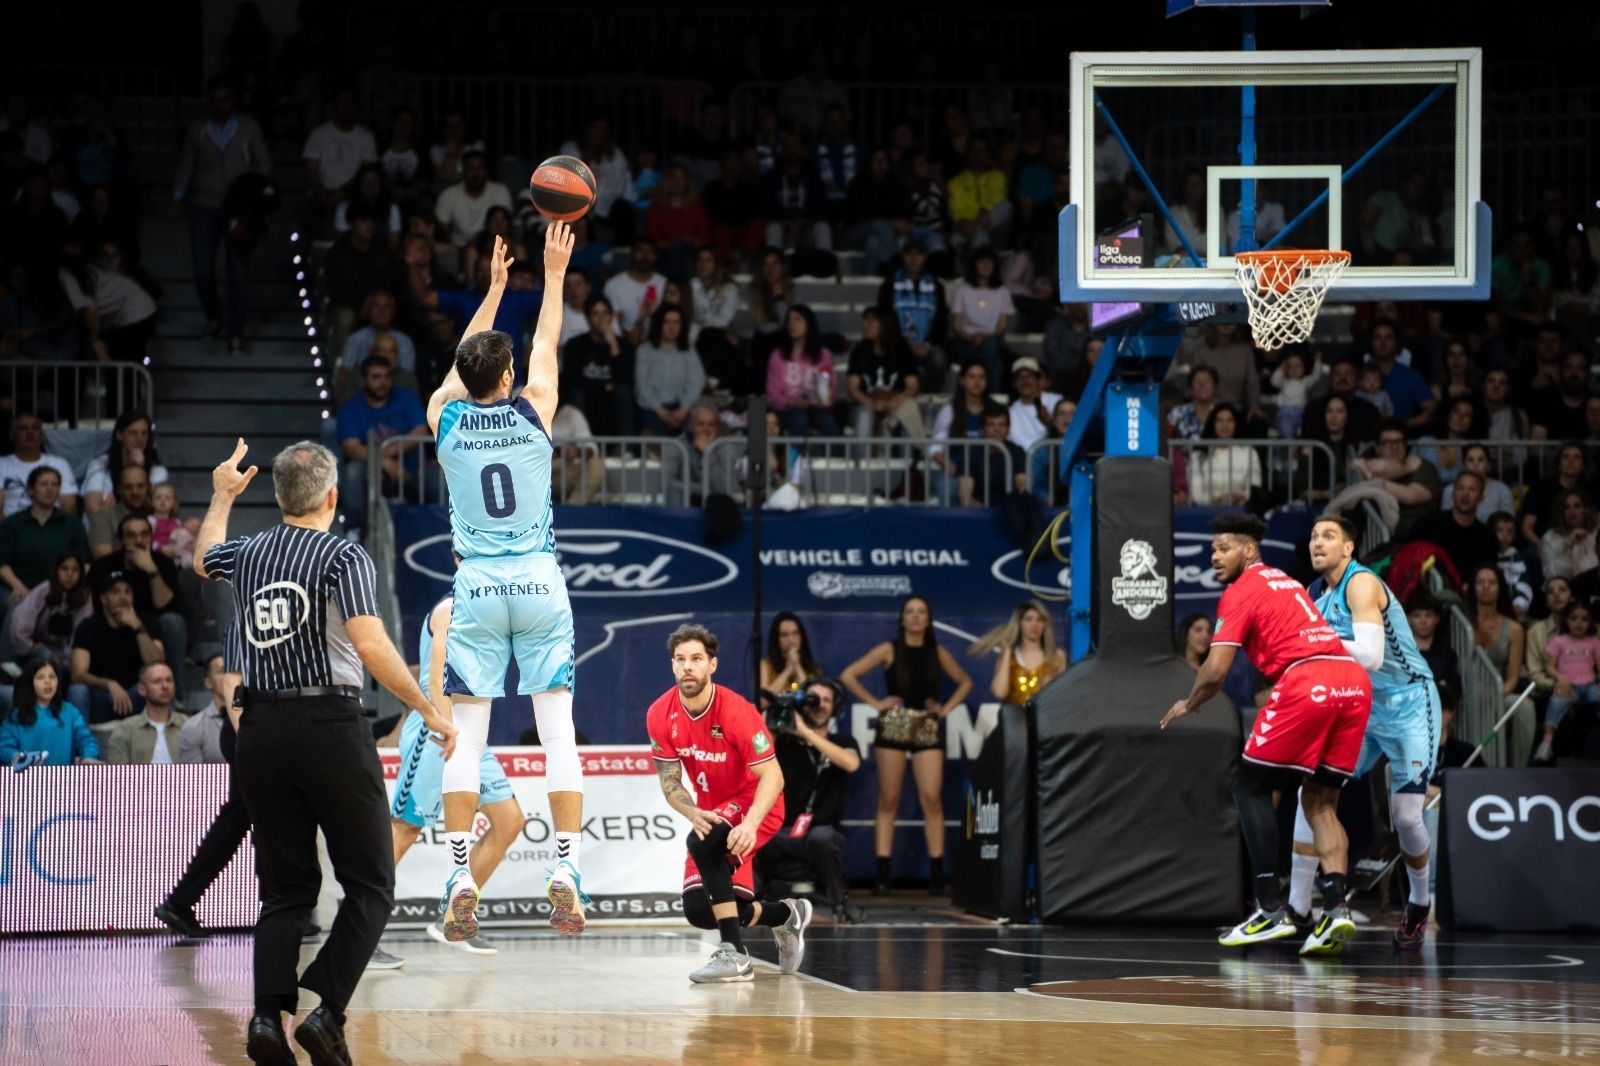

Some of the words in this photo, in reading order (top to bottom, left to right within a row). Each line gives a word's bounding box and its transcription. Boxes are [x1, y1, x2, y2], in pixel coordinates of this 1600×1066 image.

[1099, 253, 1142, 264] endesa
[1100, 244, 1120, 256] liga
[459, 407, 518, 431] ANDRIĆ
[1126, 397, 1141, 451] MONDO
[463, 434, 534, 450] MORABANC
[480, 463, 517, 518] 0
[759, 549, 862, 566] VEHICLE
[870, 548, 969, 566] OFICIAL
[1115, 588, 1164, 600] ANDORRA
[255, 597, 289, 631] 60
[1295, 592, 1318, 623] 1
[696, 772, 710, 793] 4
